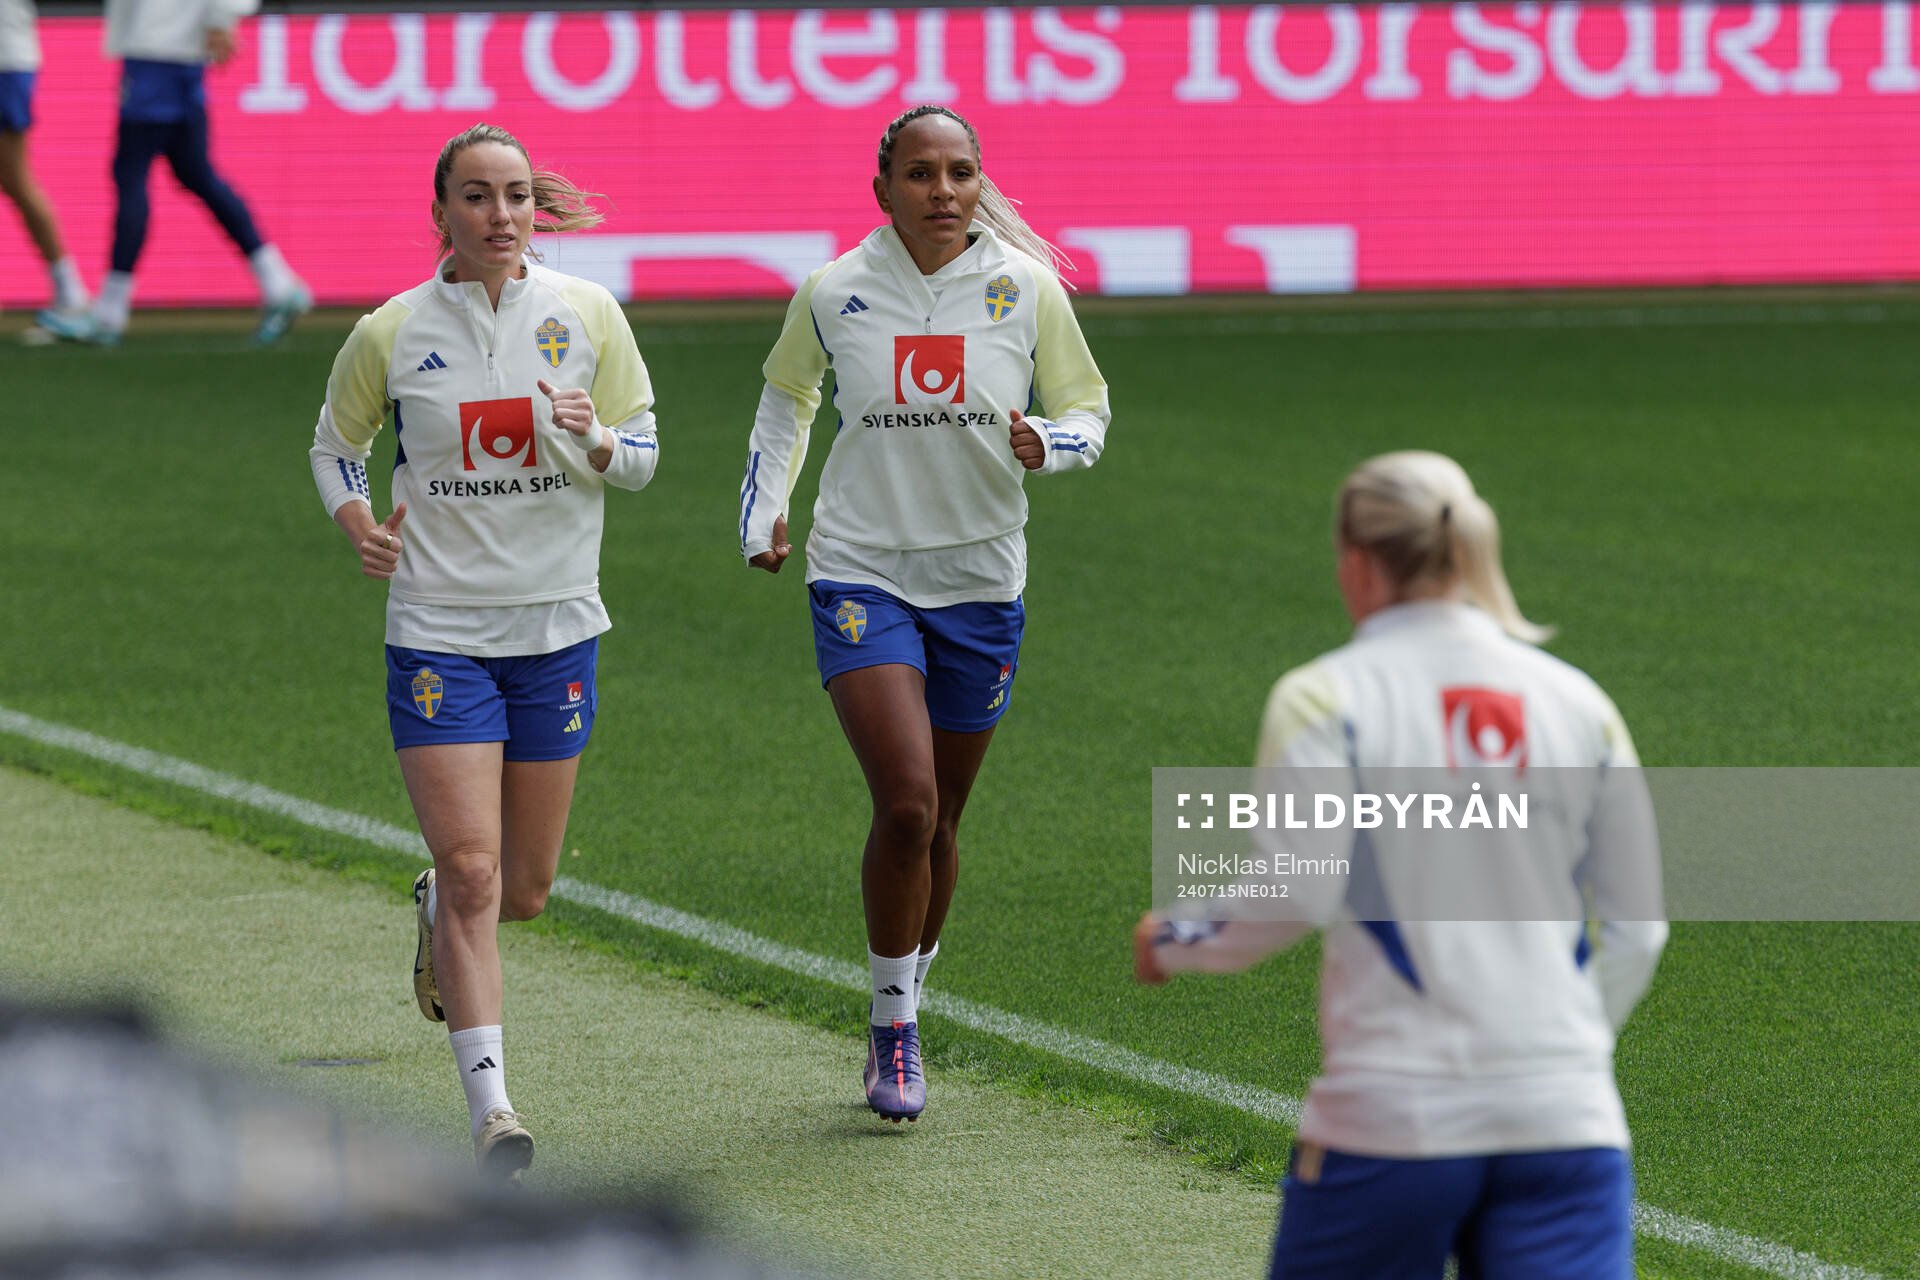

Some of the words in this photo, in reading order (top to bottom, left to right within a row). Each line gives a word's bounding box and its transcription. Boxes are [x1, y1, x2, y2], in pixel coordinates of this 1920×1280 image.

[862, 412, 952, 428] SVENSKA
[957, 412, 998, 427] SPEL
[428, 479, 523, 497] SVENSKA
[529, 472, 571, 493] SPEL
